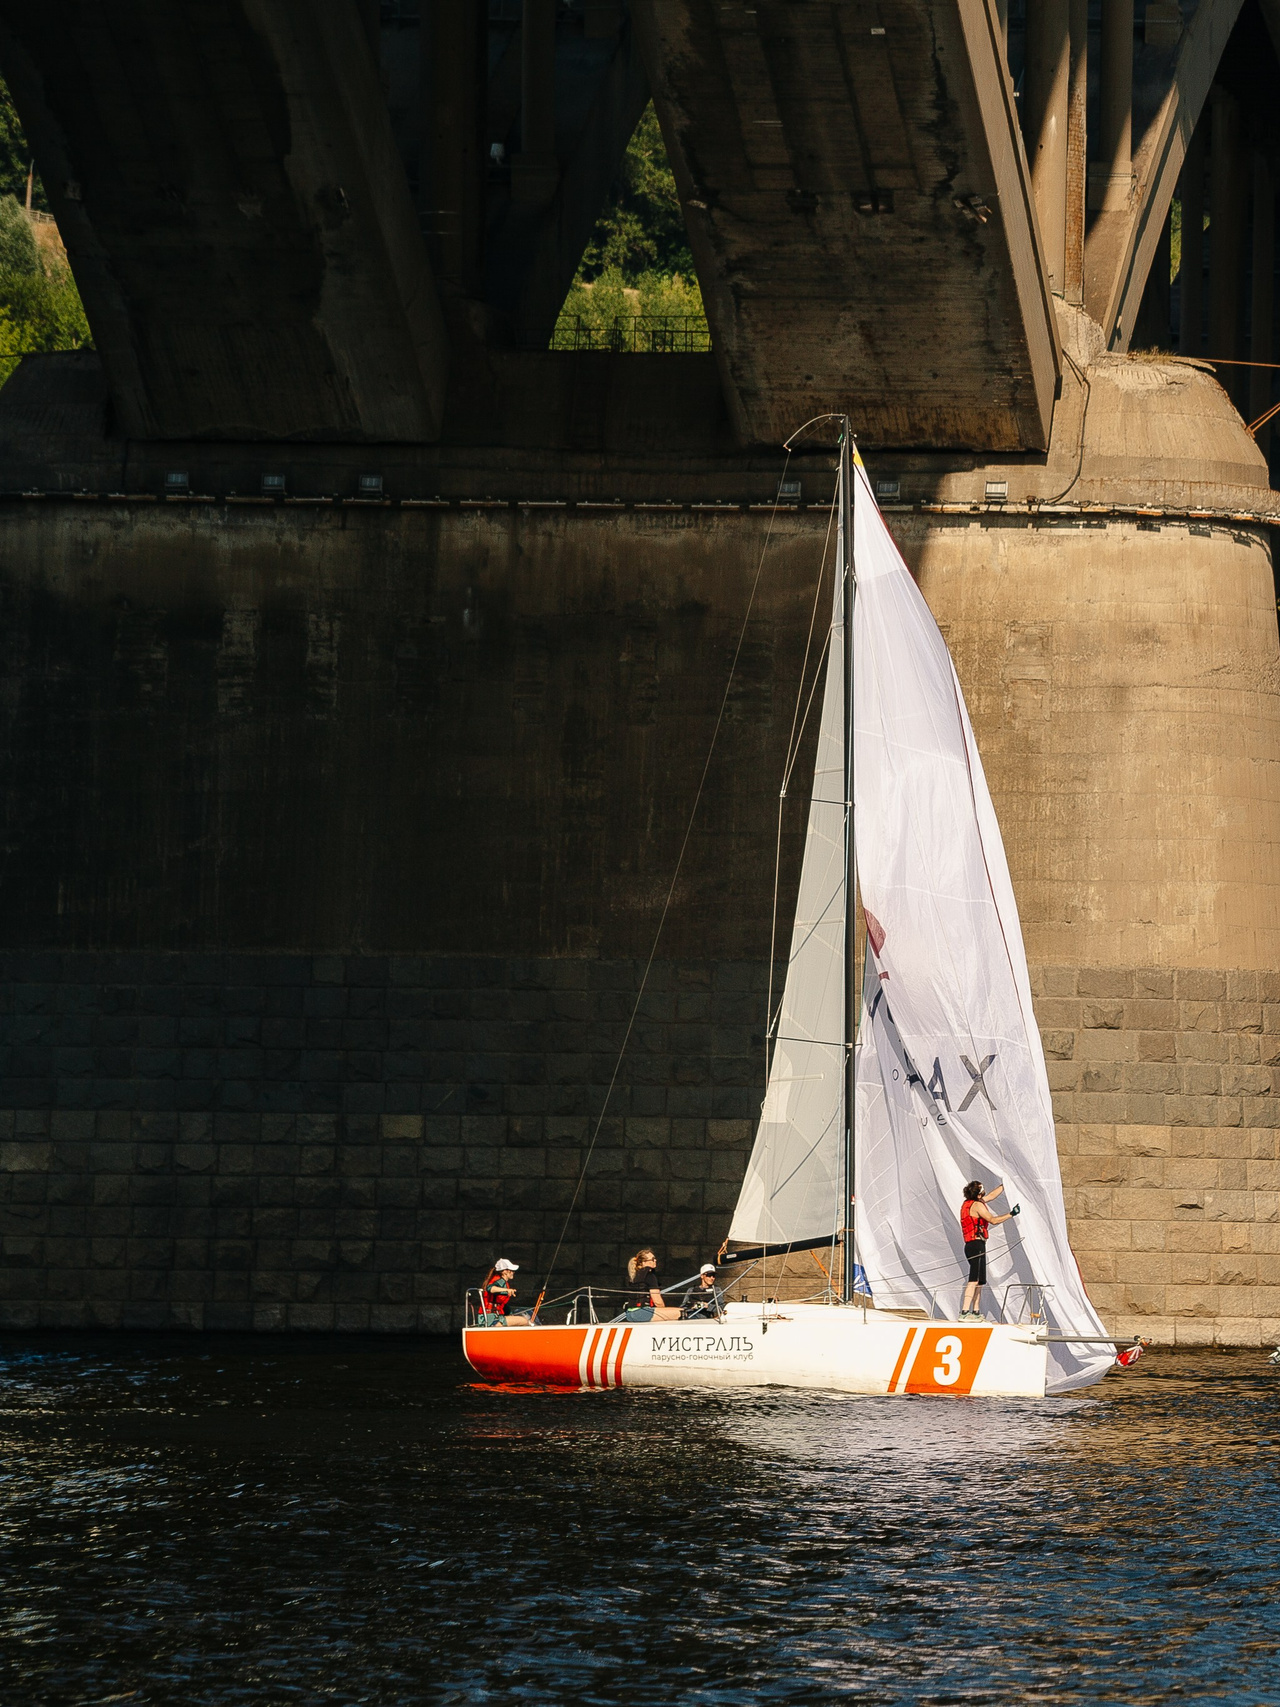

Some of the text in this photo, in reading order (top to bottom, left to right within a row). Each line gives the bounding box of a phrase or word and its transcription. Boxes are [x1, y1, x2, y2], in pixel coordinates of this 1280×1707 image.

[651, 1336, 754, 1351] МИСТРАЛЬ
[651, 1352, 754, 1362] парусно-гоночный клуб
[933, 1335, 963, 1386] 3
